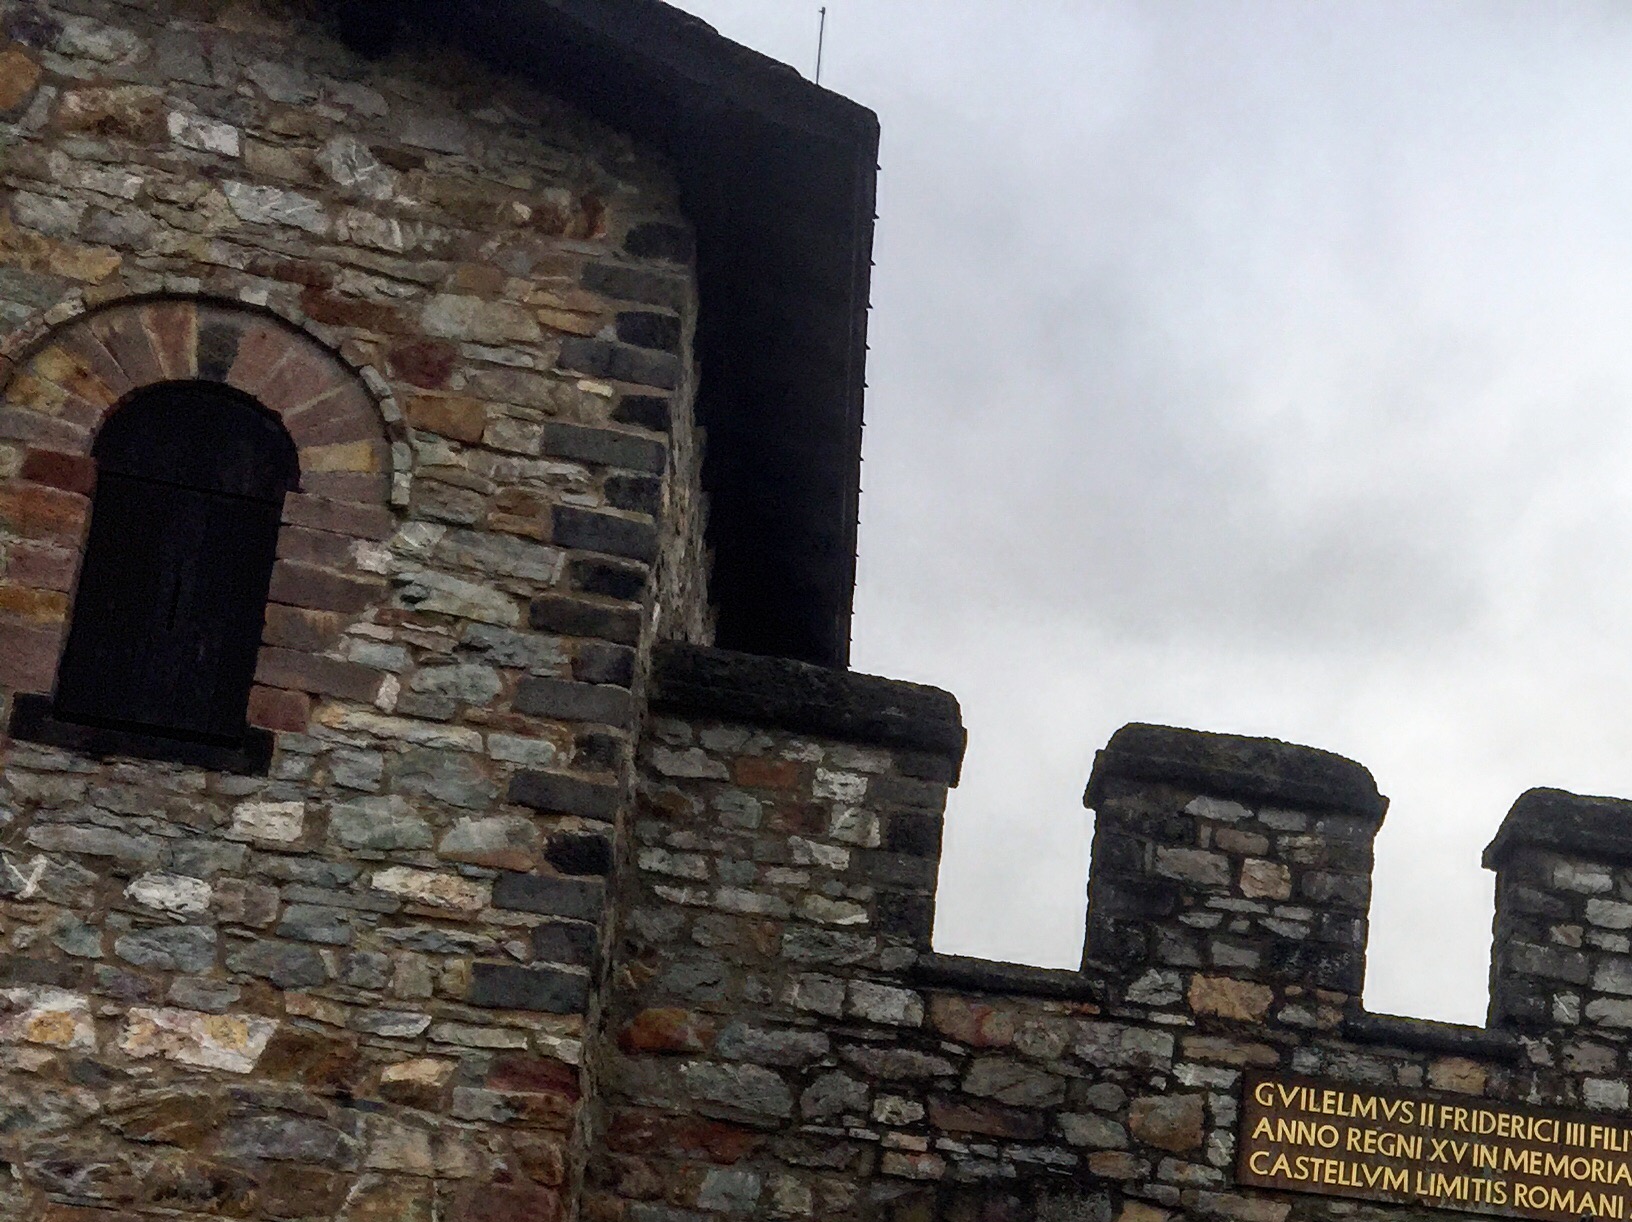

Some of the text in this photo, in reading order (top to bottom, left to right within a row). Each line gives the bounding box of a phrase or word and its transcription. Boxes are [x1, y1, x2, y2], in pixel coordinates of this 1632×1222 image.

[1251, 1116, 1340, 1149] ANNO
[1346, 1126, 1423, 1160] REGNI
[1429, 1138, 1469, 1164] XV
[1472, 1143, 1499, 1169] IN
[1254, 1082, 1414, 1124] GVILELMVS
[1419, 1102, 1435, 1127] II
[1440, 1105, 1560, 1144] FRIDERICI
[1565, 1122, 1586, 1147] III
[1249, 1150, 1409, 1193] CASTELLVM
[1414, 1170, 1508, 1205] LIMITIS
[1514, 1182, 1624, 1220] ROMANI
